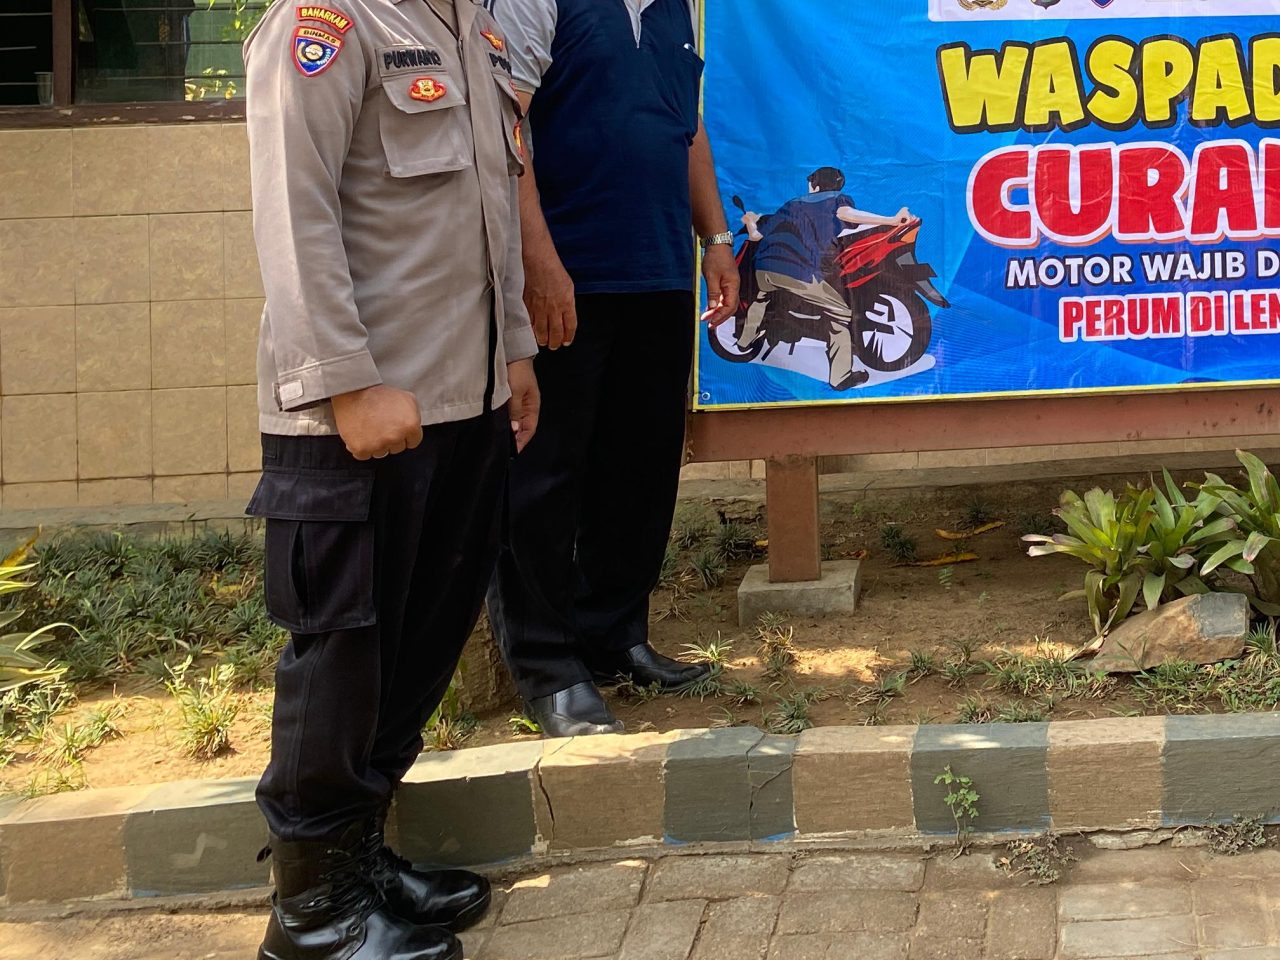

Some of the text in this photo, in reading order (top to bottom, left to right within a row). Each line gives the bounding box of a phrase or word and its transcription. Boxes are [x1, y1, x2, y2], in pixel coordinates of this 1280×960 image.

[1006, 255, 1133, 287] MOTOR
[1141, 251, 1246, 282] WAJIB
[1062, 296, 1182, 339] PERUM
[1190, 294, 1226, 333] DI
